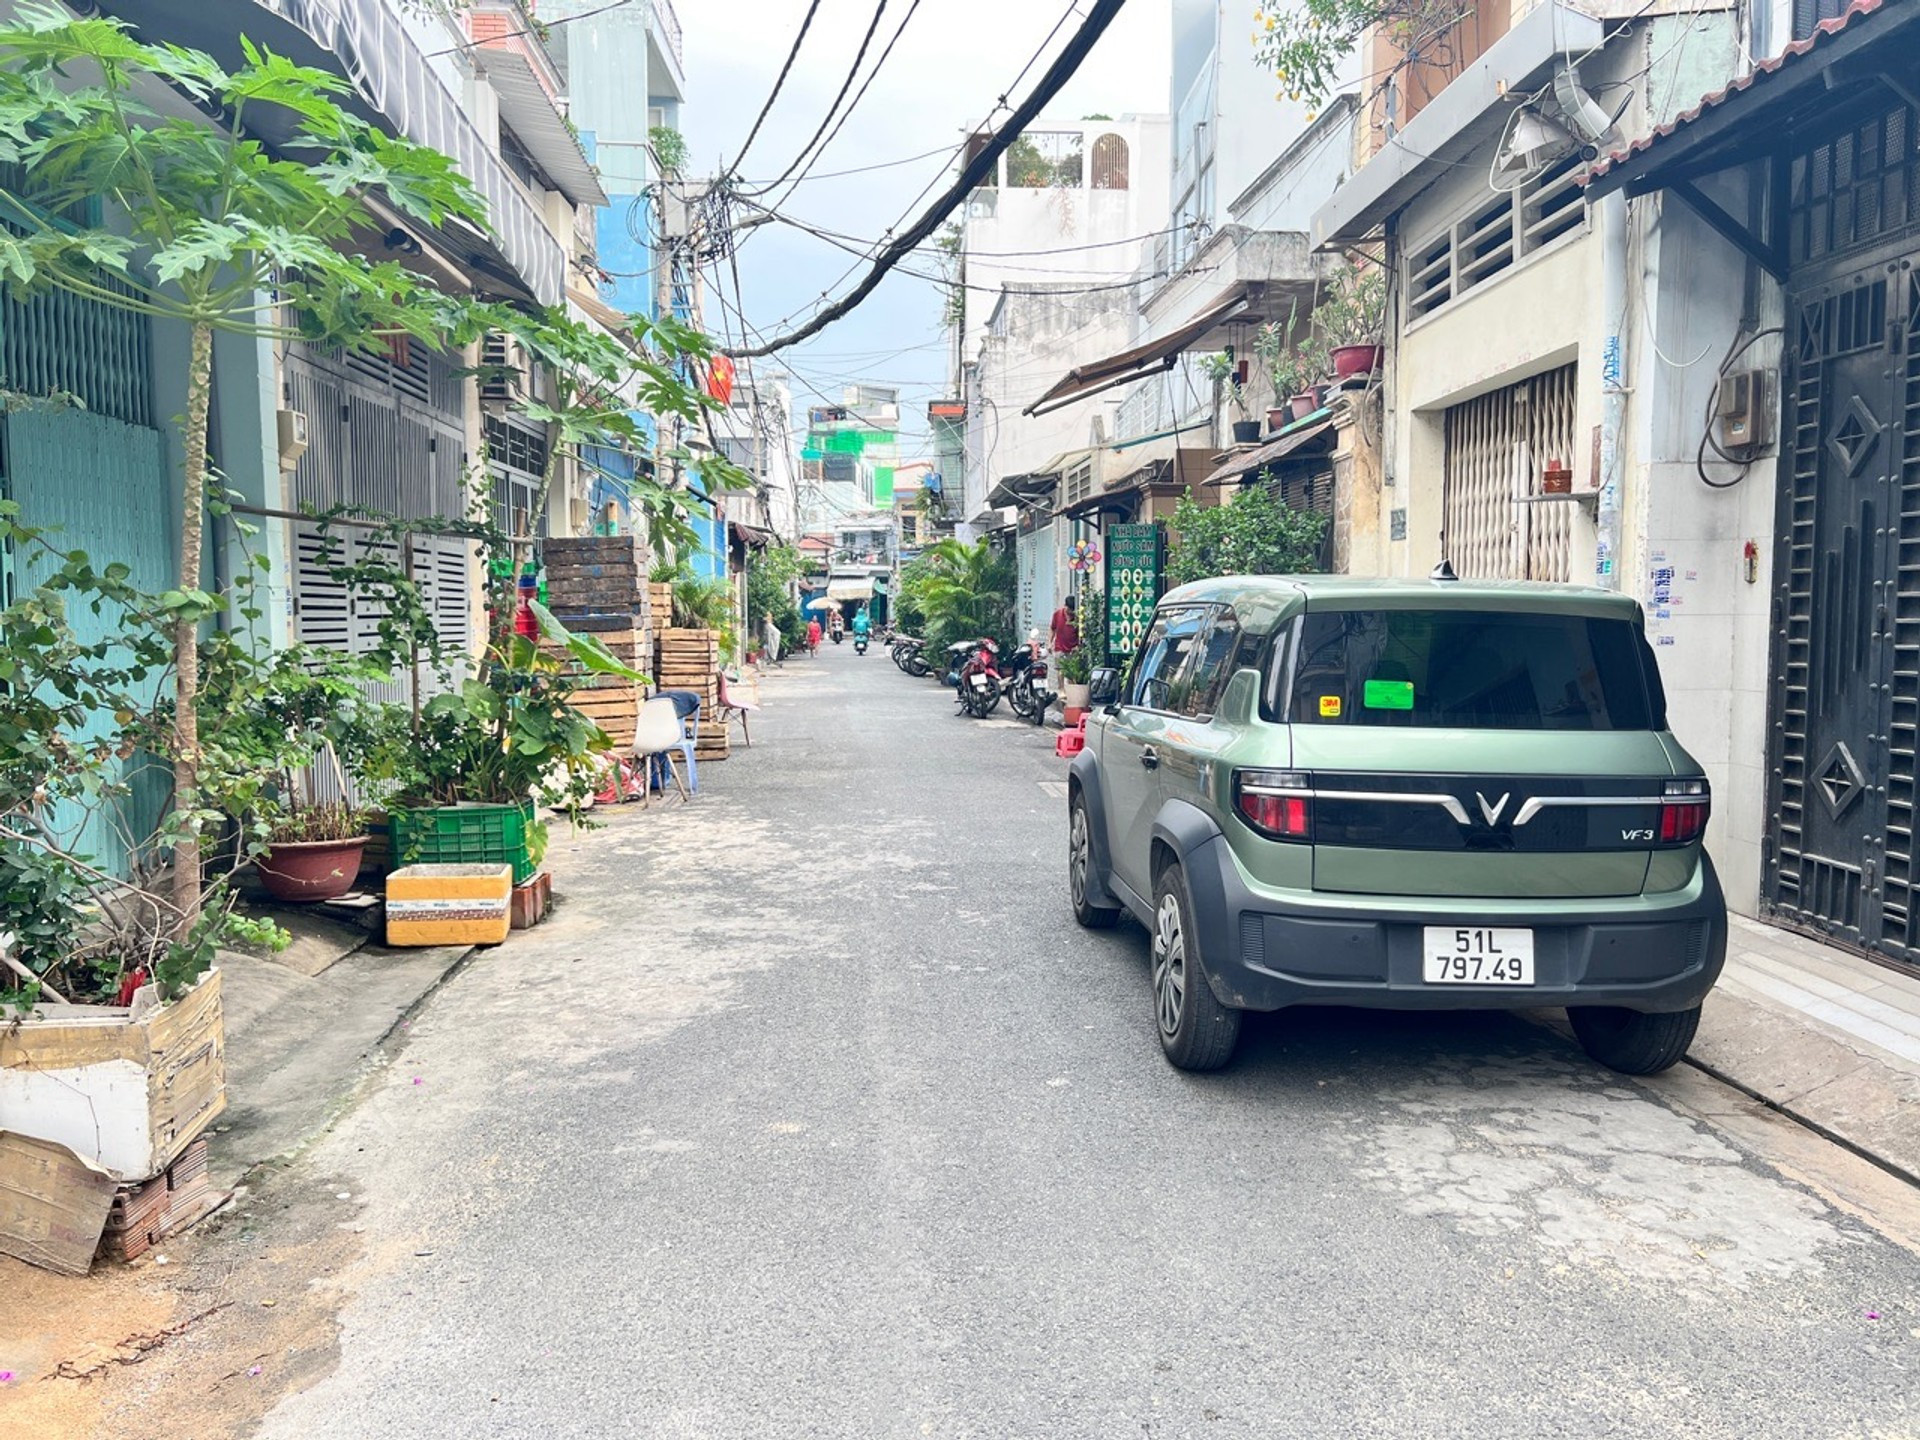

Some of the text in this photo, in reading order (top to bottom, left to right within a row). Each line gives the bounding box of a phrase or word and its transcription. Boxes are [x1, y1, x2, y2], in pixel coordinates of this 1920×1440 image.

[1323, 699, 1338, 707] 3M
[1456, 930, 1502, 954] 51L
[1437, 956, 1522, 981] 797.49
